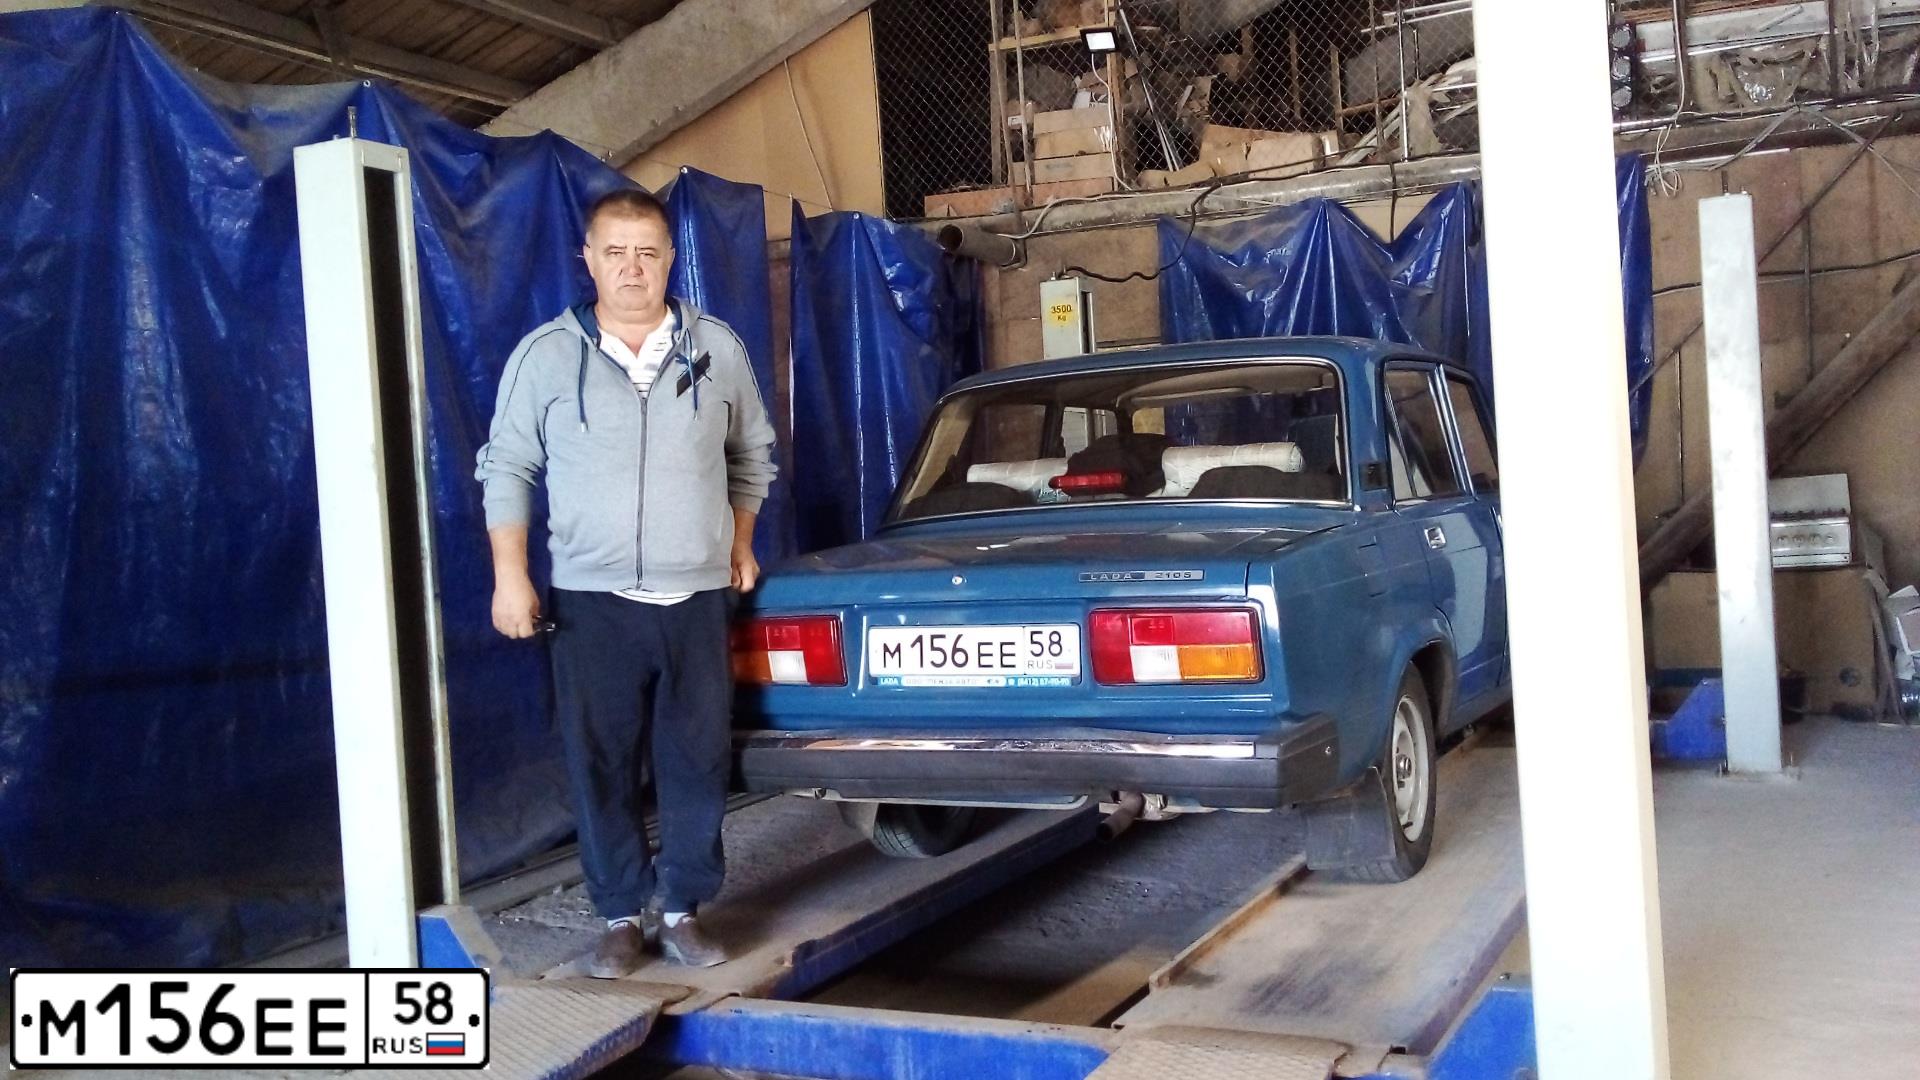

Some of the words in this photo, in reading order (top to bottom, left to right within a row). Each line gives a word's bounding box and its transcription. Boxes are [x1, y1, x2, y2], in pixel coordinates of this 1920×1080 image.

[1051, 304, 1072, 314] 3500
[1090, 573, 1132, 581] LADA
[1030, 631, 1063, 657] 58
[1027, 660, 1053, 670] RUS
